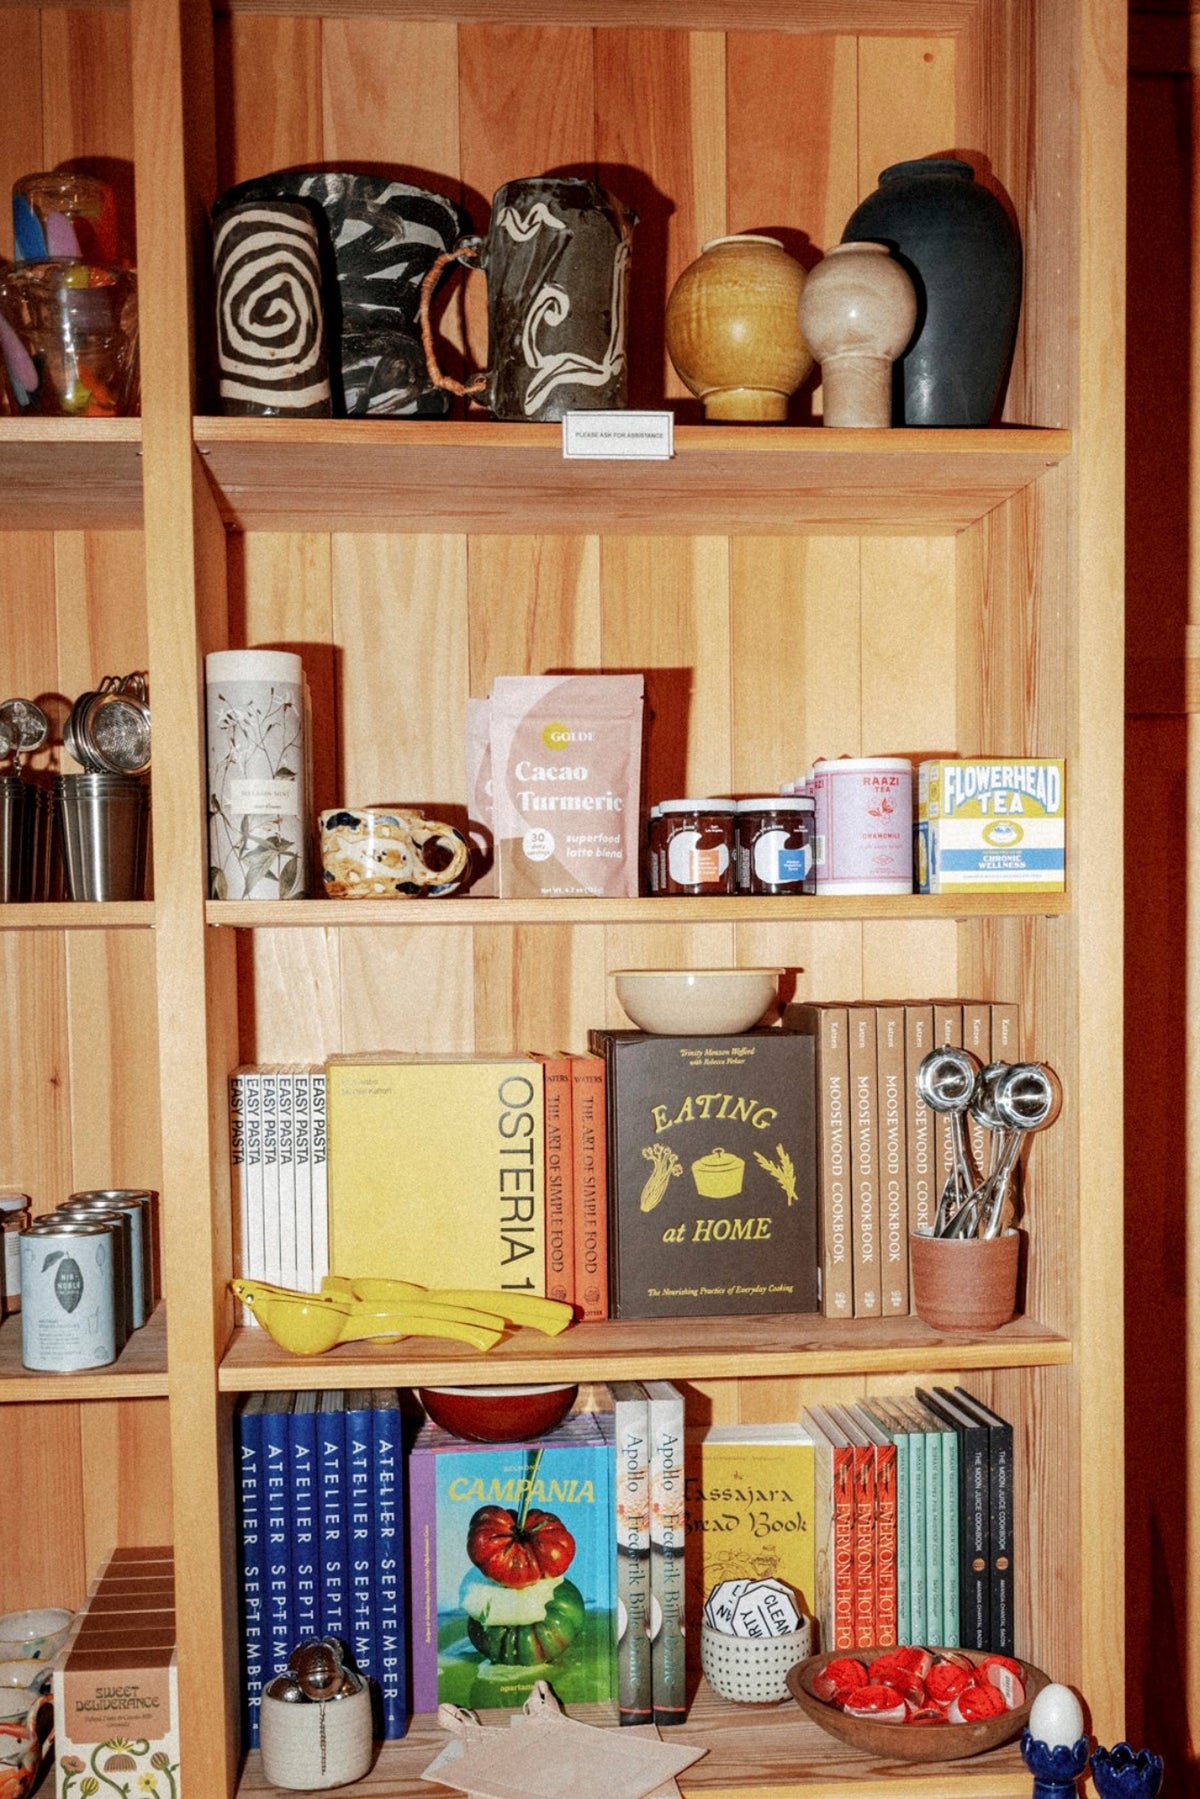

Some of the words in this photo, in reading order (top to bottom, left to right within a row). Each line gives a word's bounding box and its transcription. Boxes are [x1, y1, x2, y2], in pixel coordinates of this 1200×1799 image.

[515, 760, 588, 781] Cacao
[863, 777, 900, 786] RAAZI
[943, 765, 1060, 814] FLOWERHEAD
[516, 791, 623, 812] Turmeric
[978, 791, 1024, 814] TEA
[531, 833, 545, 842] 30
[566, 834, 620, 844] superfood
[566, 848, 594, 858] latte
[596, 848, 623, 858] blend
[231, 1079, 244, 1116] EASY
[247, 1079, 260, 1116] EASY
[263, 1078, 276, 1116] EASY
[279, 1078, 292, 1116] EASY
[295, 1078, 308, 1116] EASY
[312, 1078, 325, 1115] EASY
[548, 1095, 560, 1120] THE
[582, 1096, 594, 1122] THE
[651, 1093, 778, 1134] EATING
[232, 1120, 244, 1165] PASTA
[248, 1120, 260, 1165] PASTA
[264, 1120, 277, 1165] PASTA
[280, 1120, 292, 1165] PASTA
[296, 1120, 309, 1165] PASTA
[313, 1120, 326, 1164] PASTA
[549, 1124, 561, 1151] ART
[583, 1127, 594, 1152] ART
[830, 1076, 843, 1176] MOOSEWOOD
[858, 1076, 871, 1175] MOOSEWOOD
[886, 1075, 899, 1175] MOOSEWOOD
[498, 1076, 535, 1266] OSTERIA
[550, 1154, 560, 1172] OF
[583, 1155, 594, 1174] OF
[550, 1175, 563, 1226] SIMPLE
[584, 1176, 597, 1227] SIMPLE
[916, 1181, 928, 1228] COOKB
[662, 1223, 686, 1243] at
[692, 1217, 772, 1242] HOME
[832, 1182, 844, 1264] COOKBOOK
[860, 1182, 873, 1264] COOKBOOK
[888, 1181, 900, 1262] COOKBOOK
[551, 1230, 564, 1273] FOOD
[584, 1231, 598, 1274] FOOD
[648, 1288, 660, 1296] The
[662, 1288, 698, 1297] Nourishing
[700, 1287, 725, 1295] Practice
[727, 1286, 736, 1295] of
[736, 1285, 766, 1296] Everyday
[768, 1284, 794, 1293] Cooking
[621, 1434, 644, 1492] Apollo
[657, 1433, 680, 1491] Apollo
[733, 1470, 743, 1480] the
[974, 1452, 982, 1465] THE
[974, 1467, 982, 1489] MOON
[241, 1446, 258, 1546] ATELIER
[268, 1444, 284, 1544] ATELIER
[295, 1444, 312, 1543] ATELIER
[324, 1441, 340, 1540] ATELIER
[352, 1440, 368, 1540] ATELIER
[379, 1439, 395, 1538] ATELIER
[448, 1476, 595, 1503] CAMPANIA
[685, 1478, 793, 1511] Tassajara
[974, 1490, 982, 1511] JUICE
[749, 1511, 807, 1538] Book
[837, 1503, 850, 1585] EVERYONE
[858, 1503, 872, 1585] EVERYONE
[880, 1502, 893, 1584] EVERYONE
[974, 1512, 982, 1551] COOKBOOK
[629, 1514, 645, 1586] Frederik
[663, 1513, 680, 1584] Frederik
[298, 1565, 314, 1635] SEPTE
[326, 1562, 342, 1632] SEPTE
[354, 1561, 370, 1668] SEPTEMB
[629, 1591, 645, 1629] Bille
[664, 1590, 680, 1627] Bille
[764, 1594, 791, 1636] CLEAN
[837, 1589, 850, 1622] HOT
[858, 1589, 872, 1623] HOT
[880, 1587, 893, 1622] HOT
[244, 1566, 262, 1706] SEPTEMBER
[271, 1565, 288, 1674] SEPTEMB
[382, 1559, 398, 1699] SEPTEMBER
[740, 1610, 763, 1638] IRTY
[837, 1626, 850, 1649] PO
[858, 1626, 872, 1648] PO
[880, 1624, 893, 1646] PO
[76, 1697, 160, 1712] DELIVERANCE
[96, 1686, 139, 1699] SWEET
